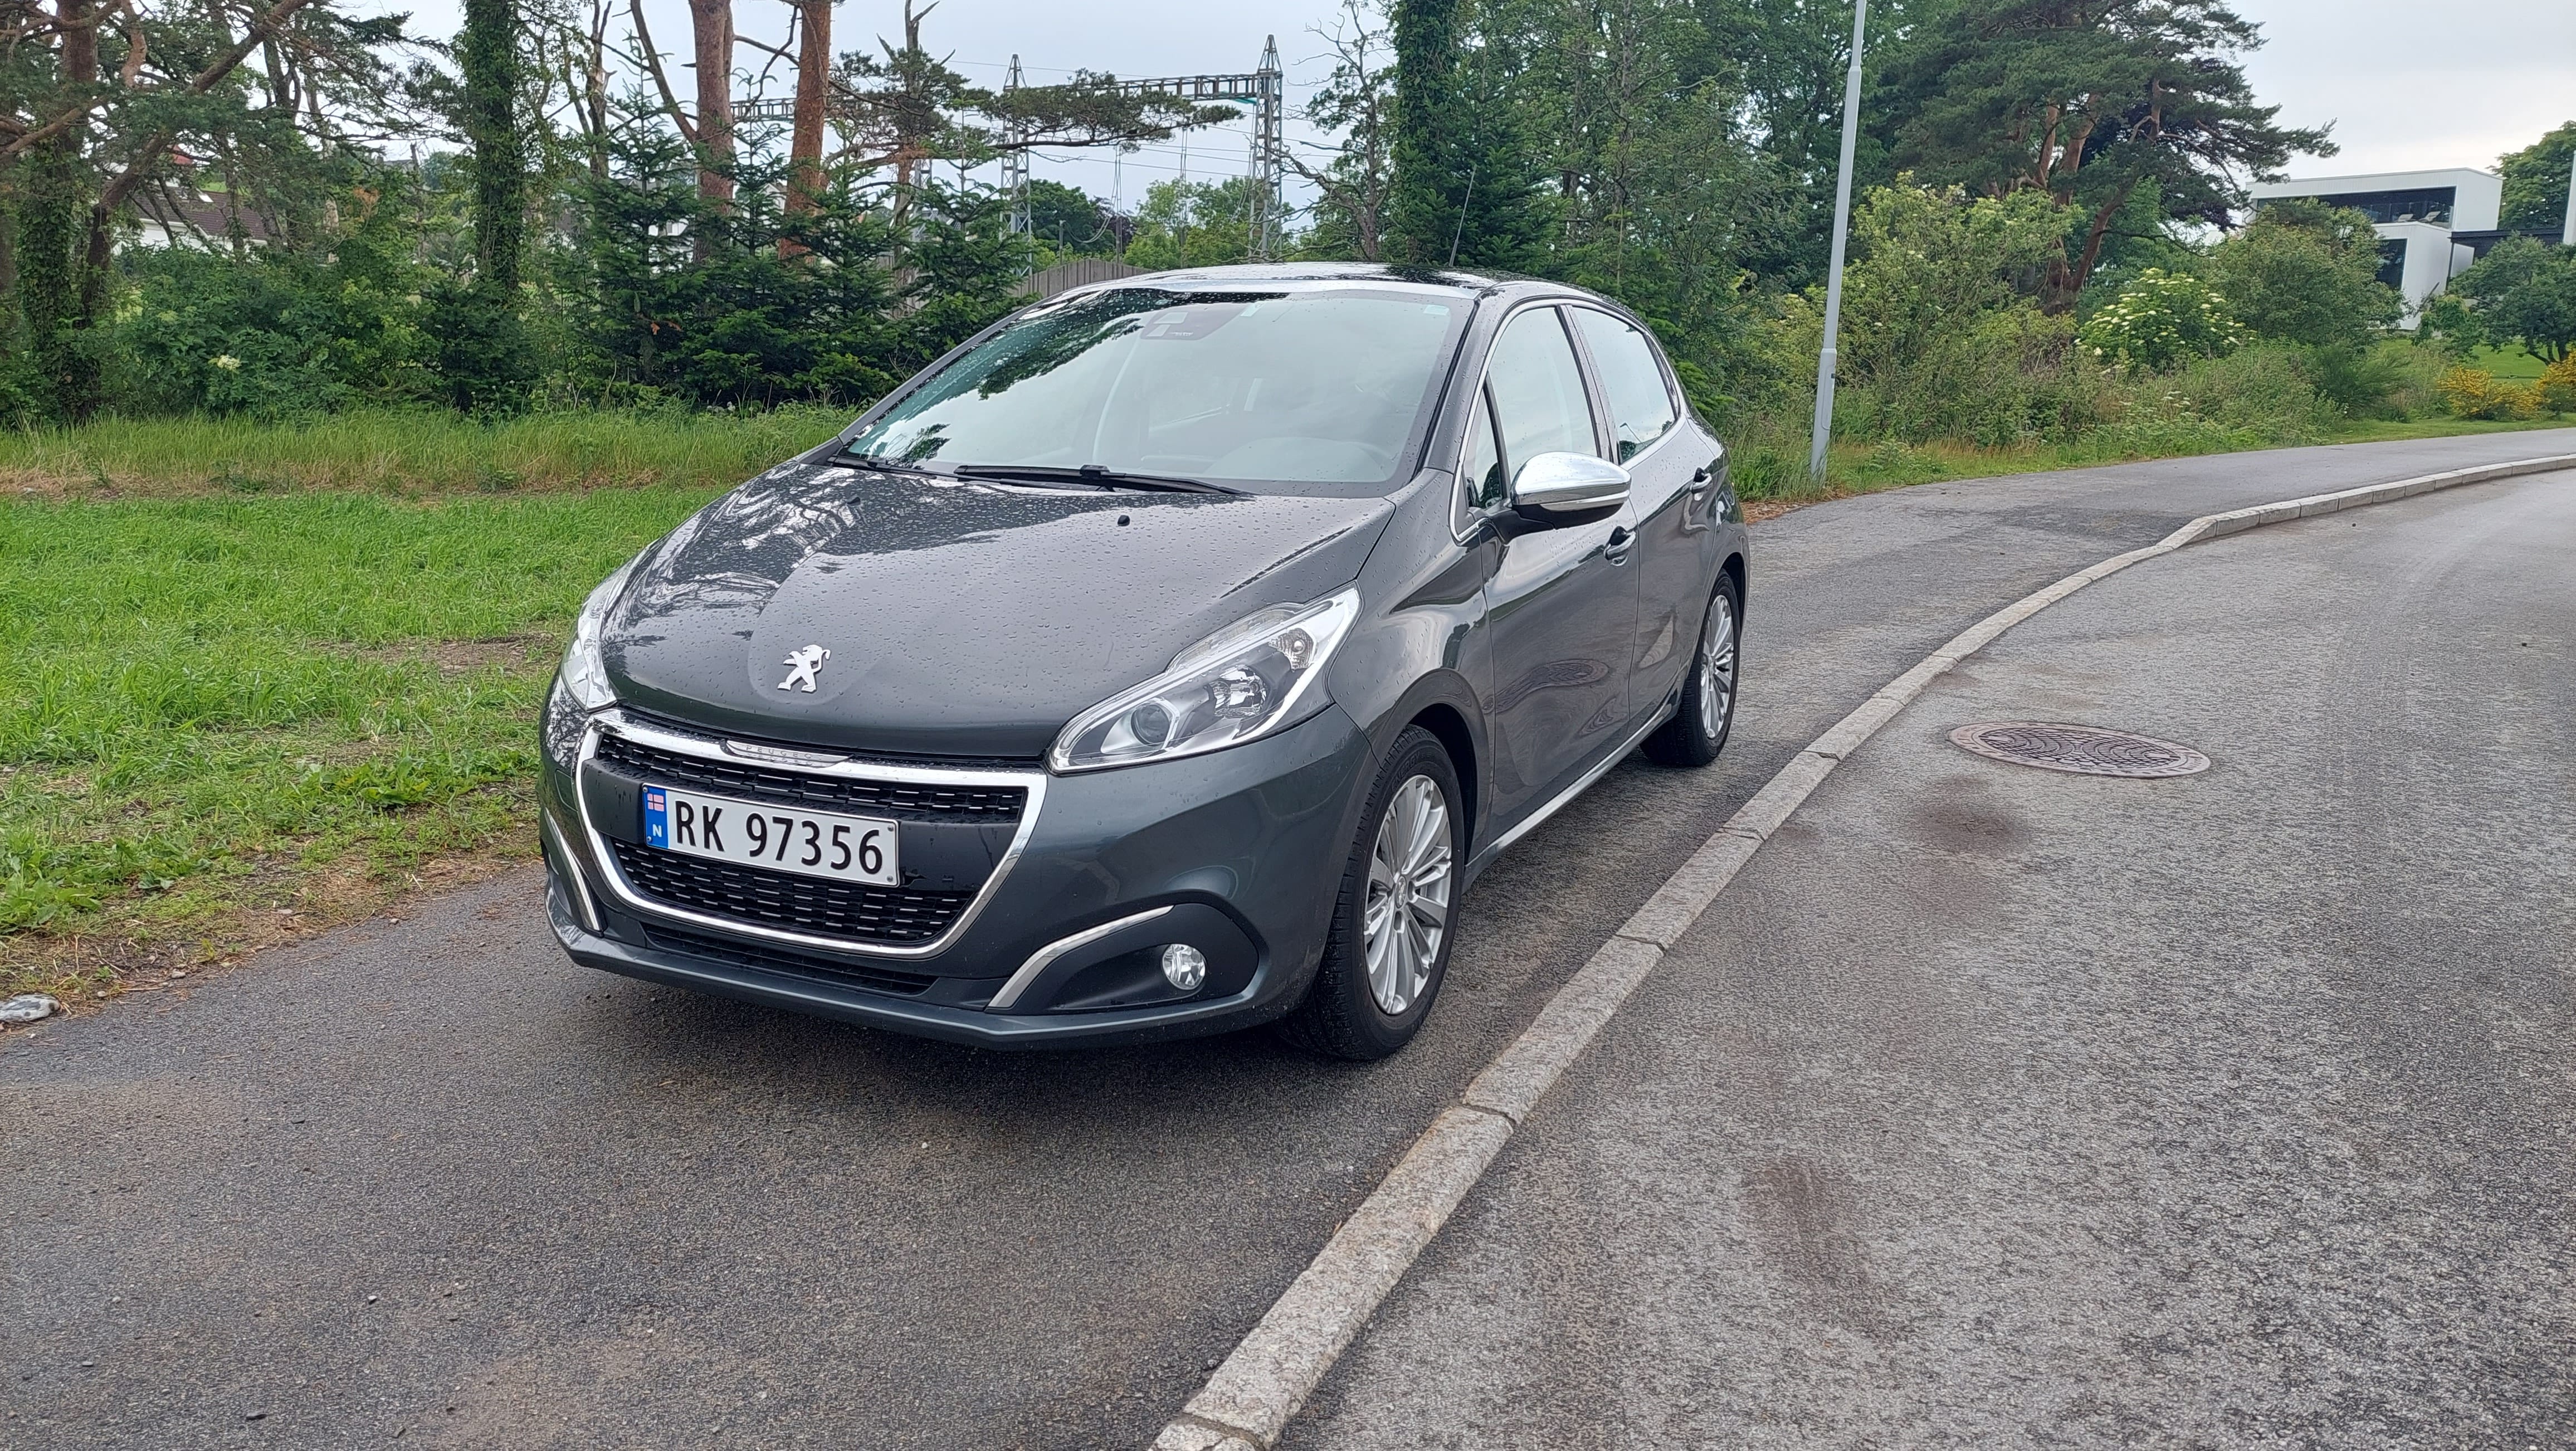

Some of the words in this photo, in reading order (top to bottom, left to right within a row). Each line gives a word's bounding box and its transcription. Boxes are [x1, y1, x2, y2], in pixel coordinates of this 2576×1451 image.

[652, 824, 662, 838] N
[675, 800, 725, 852] RK
[745, 812, 883, 874] 97356
